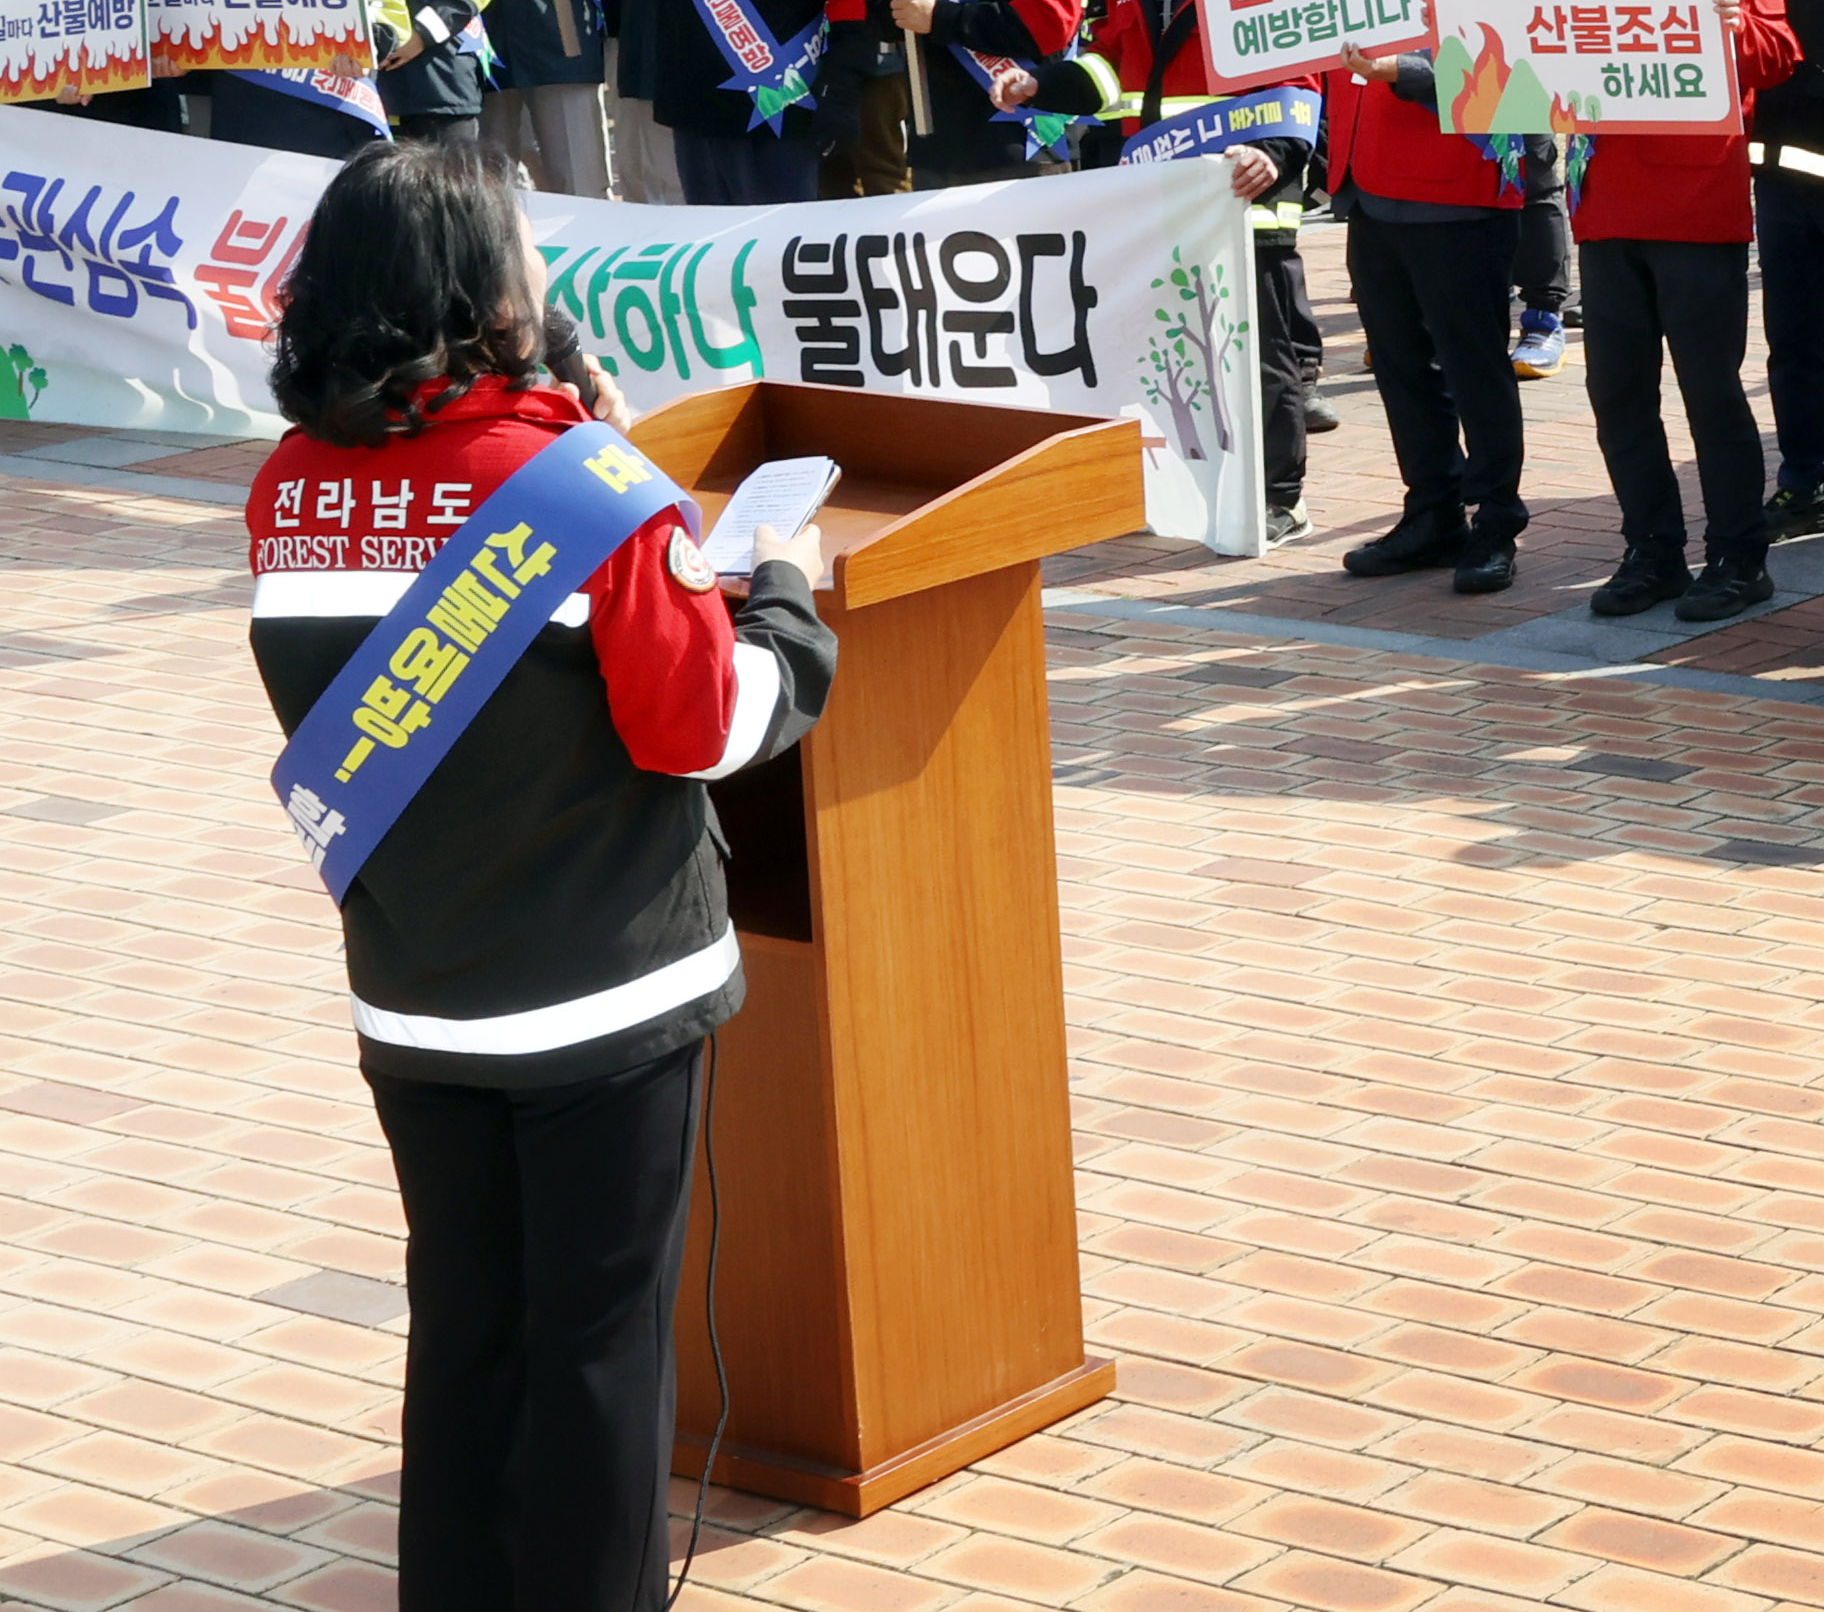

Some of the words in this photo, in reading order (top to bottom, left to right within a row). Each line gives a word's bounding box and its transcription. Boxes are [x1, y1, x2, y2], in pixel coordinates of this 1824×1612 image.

[1525, 4, 1702, 55] 산불조심
[1601, 62, 1706, 100] 하세요
[782, 231, 1098, 388] 불태운다
[274, 478, 473, 529] 전라남도
[256, 535, 349, 572] FOREST
[333, 522, 557, 783] 산불예방!
